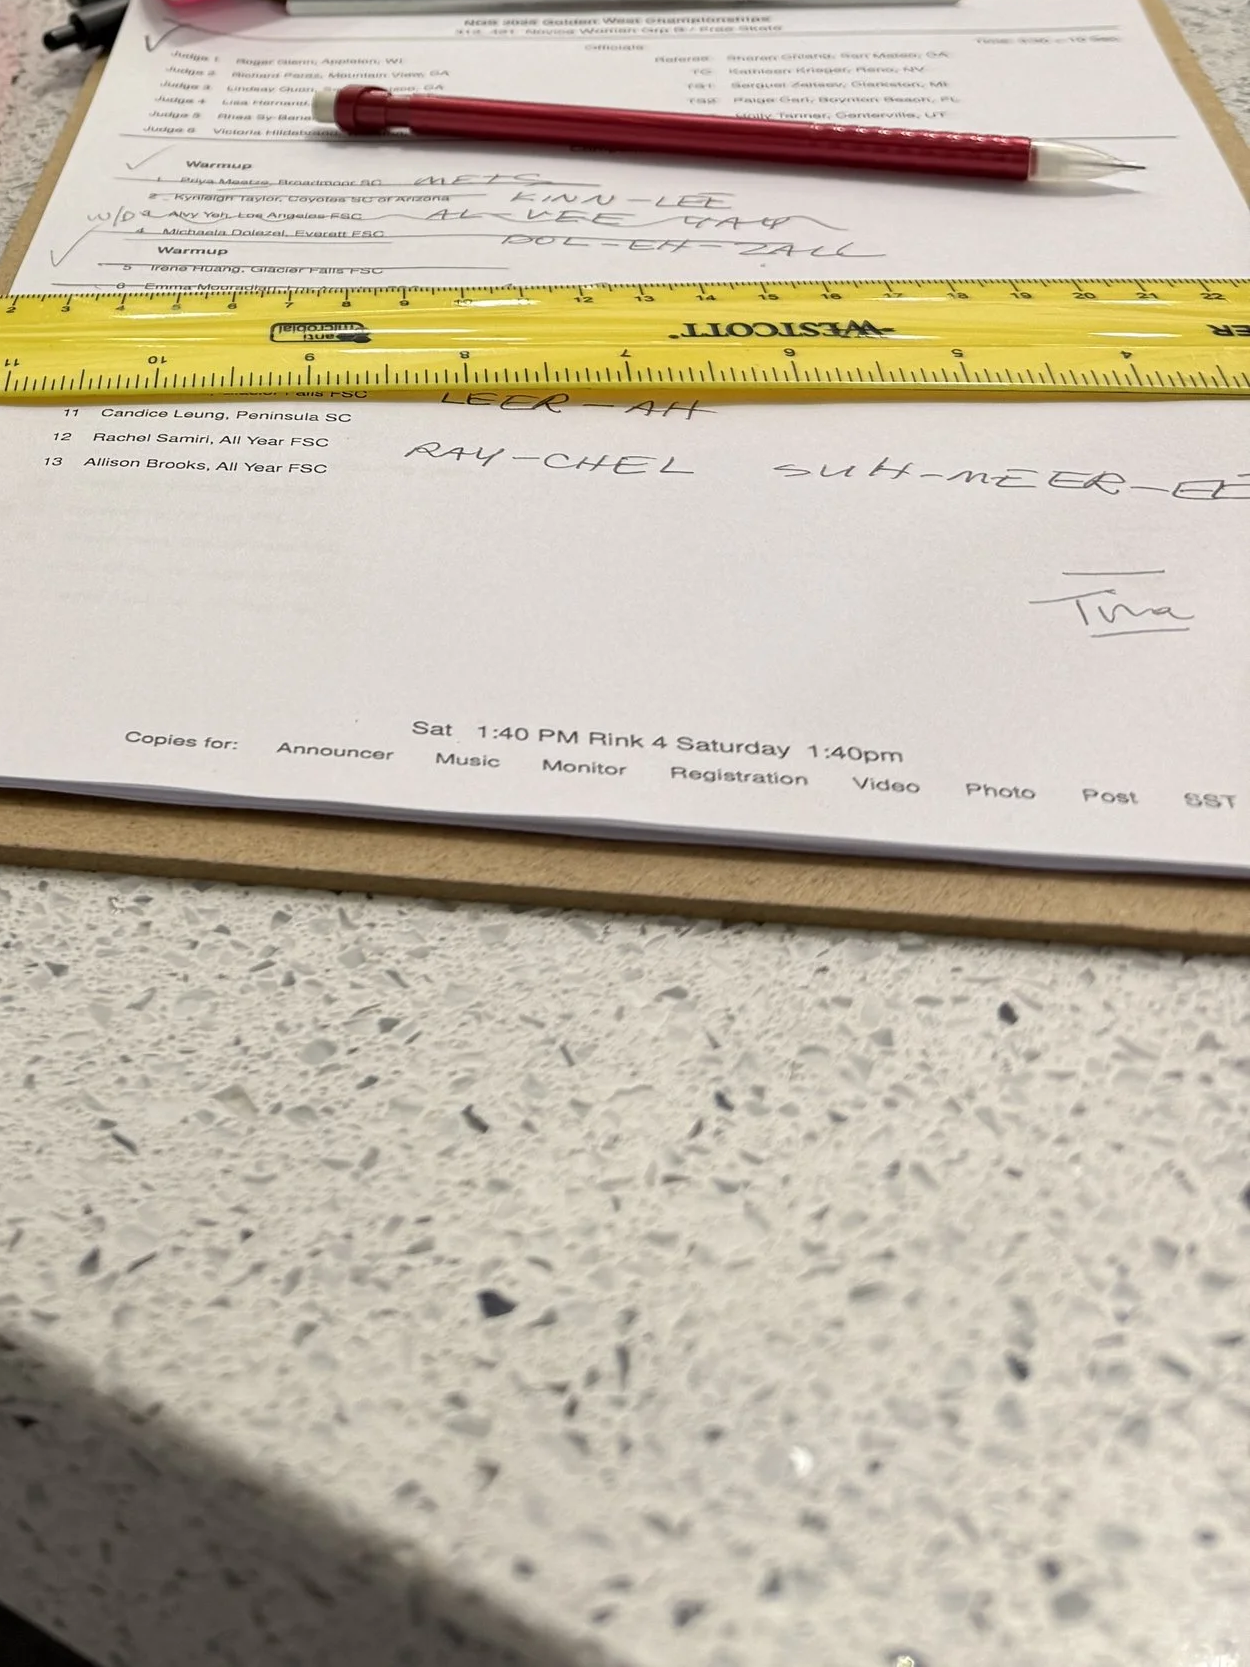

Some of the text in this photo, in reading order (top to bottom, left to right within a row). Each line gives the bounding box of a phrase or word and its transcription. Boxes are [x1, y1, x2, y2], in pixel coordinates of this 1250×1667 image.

[170, 50, 209, 62] Judge
[165, 66, 203, 77] Judge
[160, 80, 200, 91] Judge
[154, 95, 194, 105] Judge
[149, 111, 190, 120] Judge
[143, 125, 185, 135] Judge
[213, 128, 262, 136] Victoria
[186, 160, 252, 170] Warmup
[395, 194, 450, 202] Arizona
[162, 227, 227, 236] Michaela
[294, 230, 347, 238] Everett
[351, 230, 385, 238] FSC
[157, 246, 229, 256] Warmup
[150, 264, 188, 272] Irene
[192, 265, 246, 274] Huang,
[250, 266, 304, 274] Glacier
[144, 282, 192, 291] Emma
[5, 306, 17, 314] 2
[61, 305, 71, 313] 3
[115, 304, 126, 312] 4
[171, 303, 182, 311] 5
[285, 301, 295, 309] 7
[341, 300, 352, 308] 8
[399, 300, 410, 308] 9
[574, 296, 595, 304] 12
[634, 294, 655, 302] 13
[695, 294, 717, 302] 14
[758, 293, 780, 301] 15
[819, 292, 842, 301] 16
[946, 291, 969, 300] 18
[1009, 291, 1032, 300] 19
[1072, 291, 1097, 300] 20
[1135, 291, 1158, 300] 21
[1199, 291, 1226, 301] 22
[680, 319, 888, 339] WESTCOTT
[304, 352, 316, 361] 9
[459, 350, 470, 359] 8
[620, 348, 632, 358] 7
[783, 348, 796, 358] 6
[950, 348, 964, 358] 5
[1120, 349, 1133, 360] 4
[4, 358, 20, 367] 11
[147, 355, 168, 365] 10
[63, 408, 352, 423] 11 Candice Leung, Peninsula SC
[52, 431, 329, 447] 12 Rachel Samiri, All Year FSC
[43, 457, 328, 474] 13 Allison Brooks, All Year FSC
[411, 720, 904, 765] Sat 1:40 PM Rink 4 Saturday 1:40pm
[125, 730, 1238, 810] Copies for: Announcer Music Monitor Registration Video Photo Post SST
